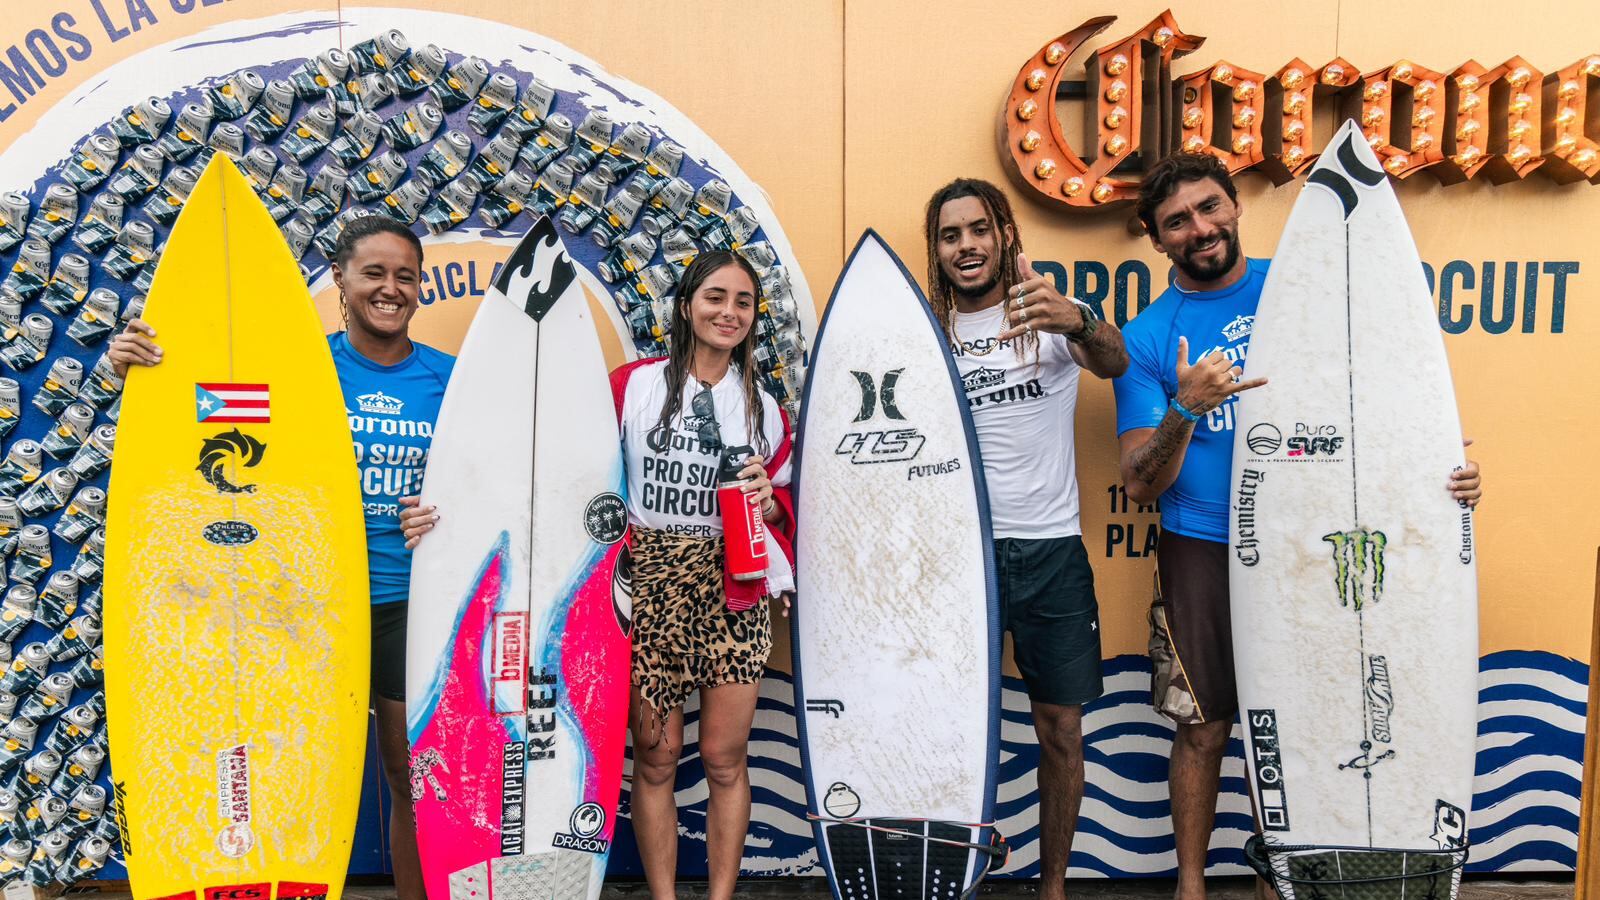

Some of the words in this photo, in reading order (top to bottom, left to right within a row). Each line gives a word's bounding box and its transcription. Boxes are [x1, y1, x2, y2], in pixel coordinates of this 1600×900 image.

[344, 407, 434, 439] orona
[1295, 423, 1337, 435] Puro
[369, 443, 430, 467] SUR
[1287, 437, 1344, 456] SURF
[358, 466, 424, 496] CUIT
[643, 456, 683, 484] PRO
[687, 463, 719, 489] SU
[908, 458, 961, 480] FUTURES
[1234, 469, 1266, 567] Chemistry
[1460, 513, 1473, 565] Custom
[527, 665, 557, 761] REEF
[1252, 714, 1281, 784] OTIS
[221, 751, 230, 817] EMPRESAS
[233, 744, 250, 823] SANTANA
[503, 742, 524, 804] EXPRESS
[553, 834, 608, 853] DRAGON
